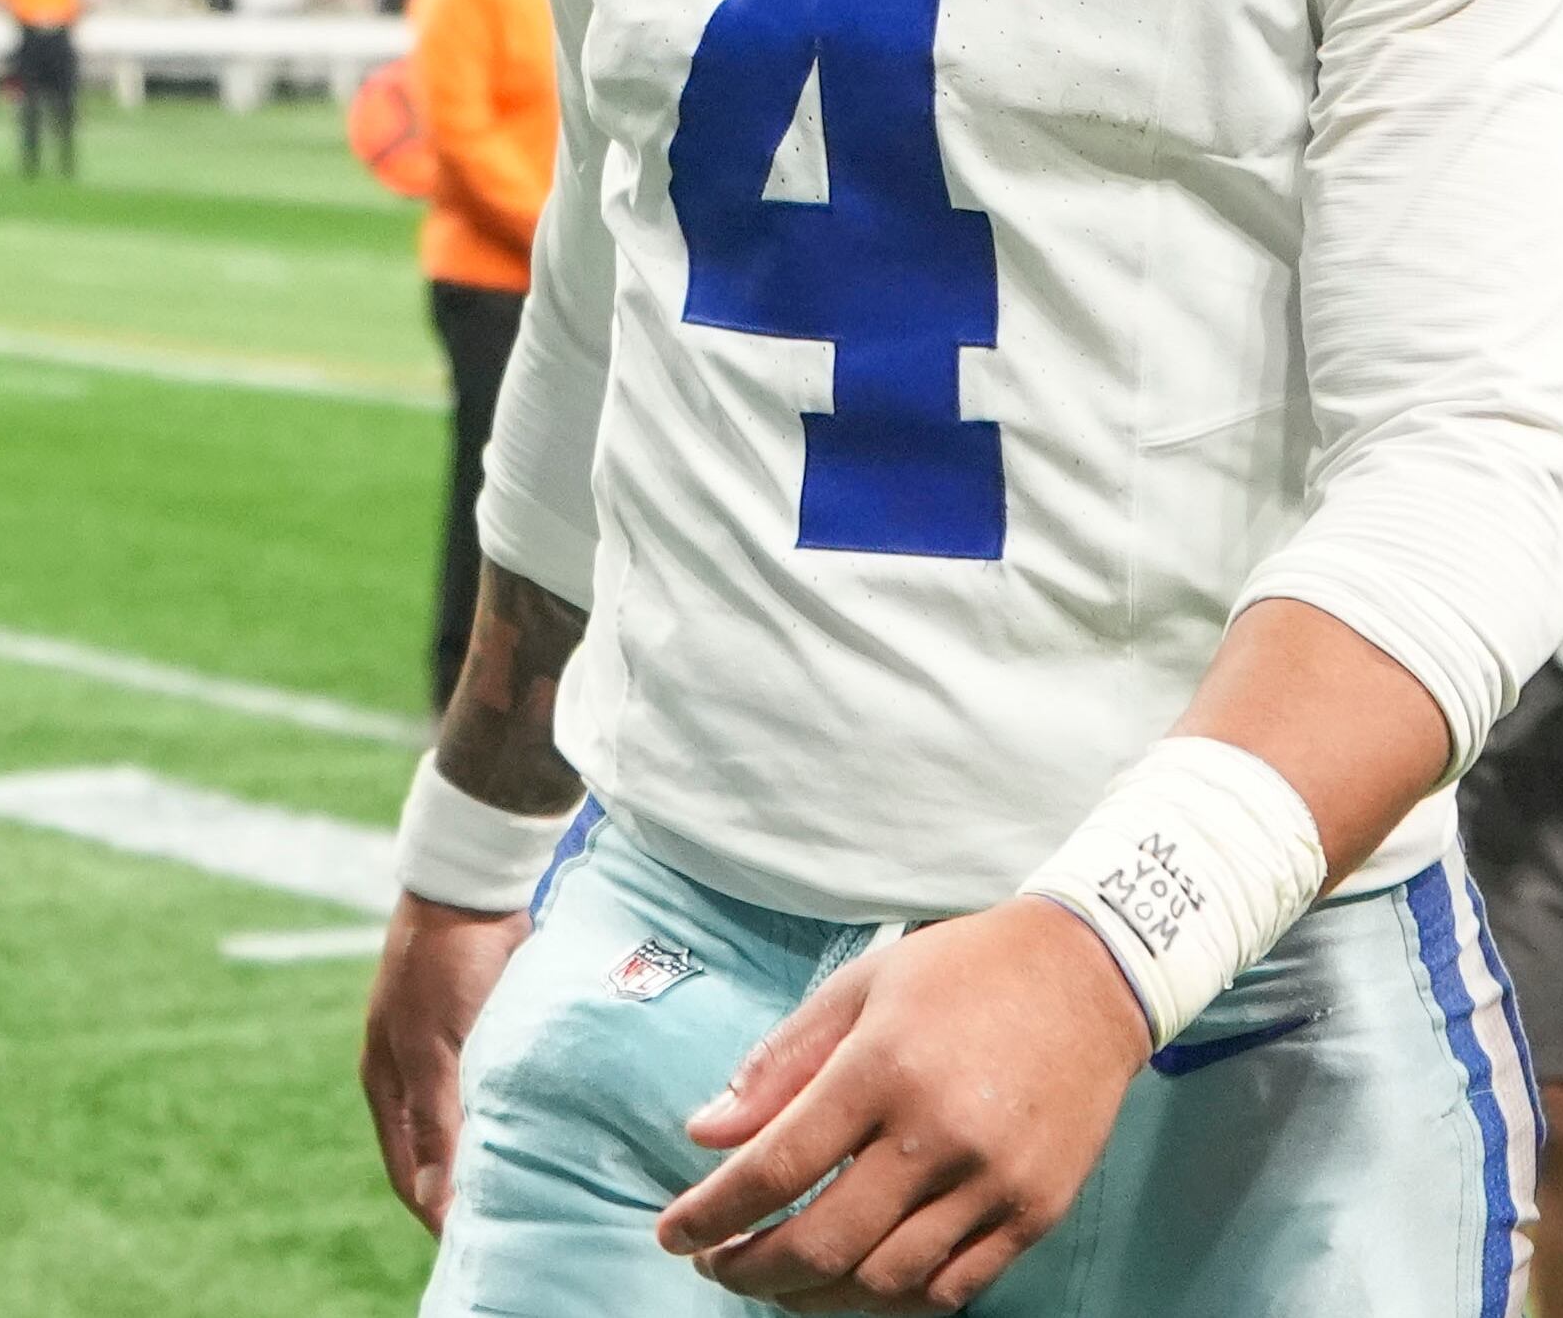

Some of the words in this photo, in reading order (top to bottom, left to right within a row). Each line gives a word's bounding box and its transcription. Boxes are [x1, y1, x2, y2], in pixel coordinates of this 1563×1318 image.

[1098, 869, 1179, 951] MOM
[1136, 859, 1186, 919] YOU
[615, 957, 661, 990] NFL
